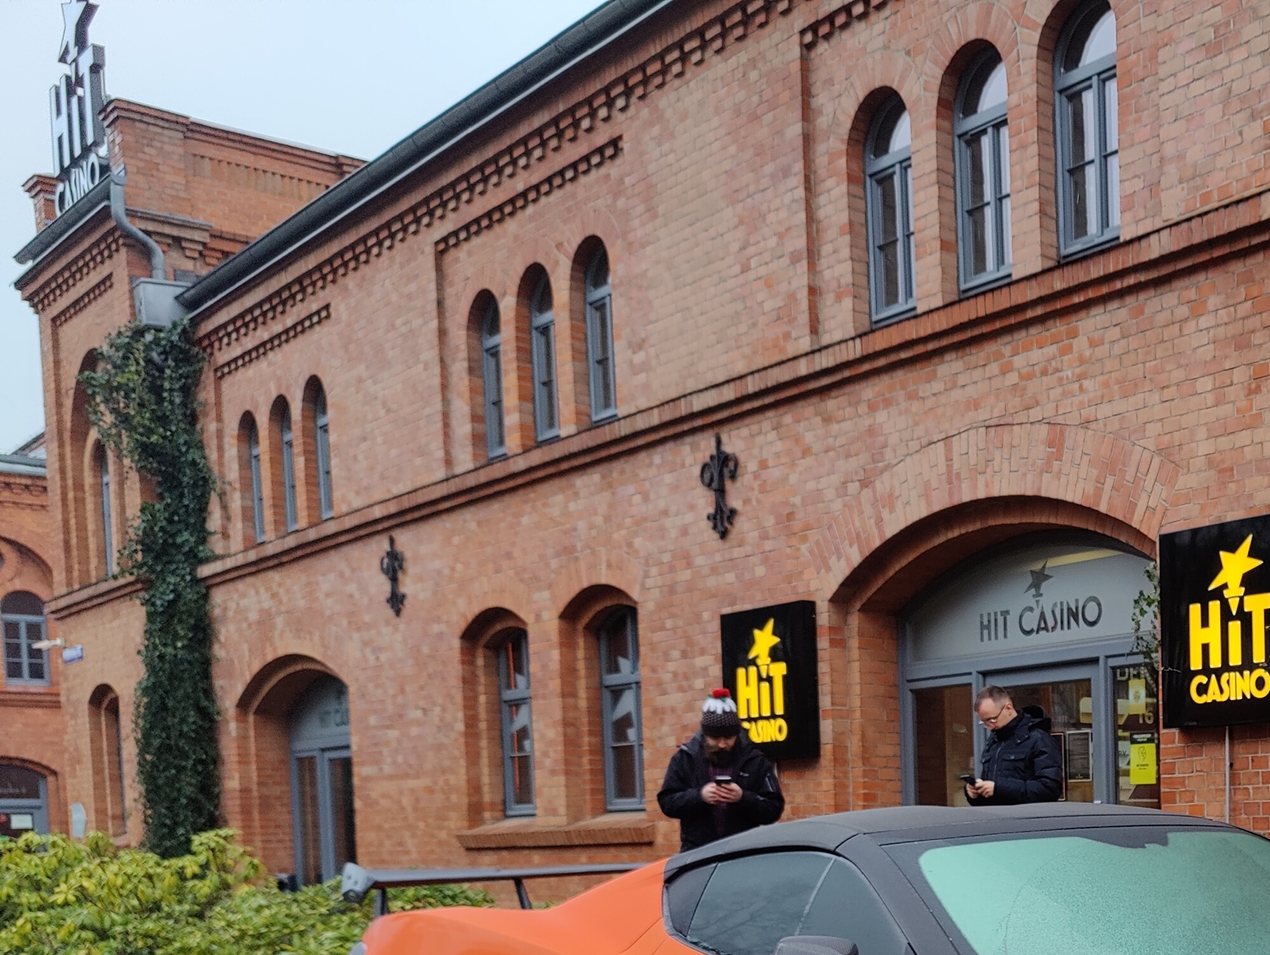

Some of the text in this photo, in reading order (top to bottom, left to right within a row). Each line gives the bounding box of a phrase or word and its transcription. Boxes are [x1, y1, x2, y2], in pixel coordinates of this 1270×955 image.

[55, 153, 100, 216] CASINO
[980, 595, 1103, 643] HIT CASINO
[741, 717, 788, 743] ASINO
